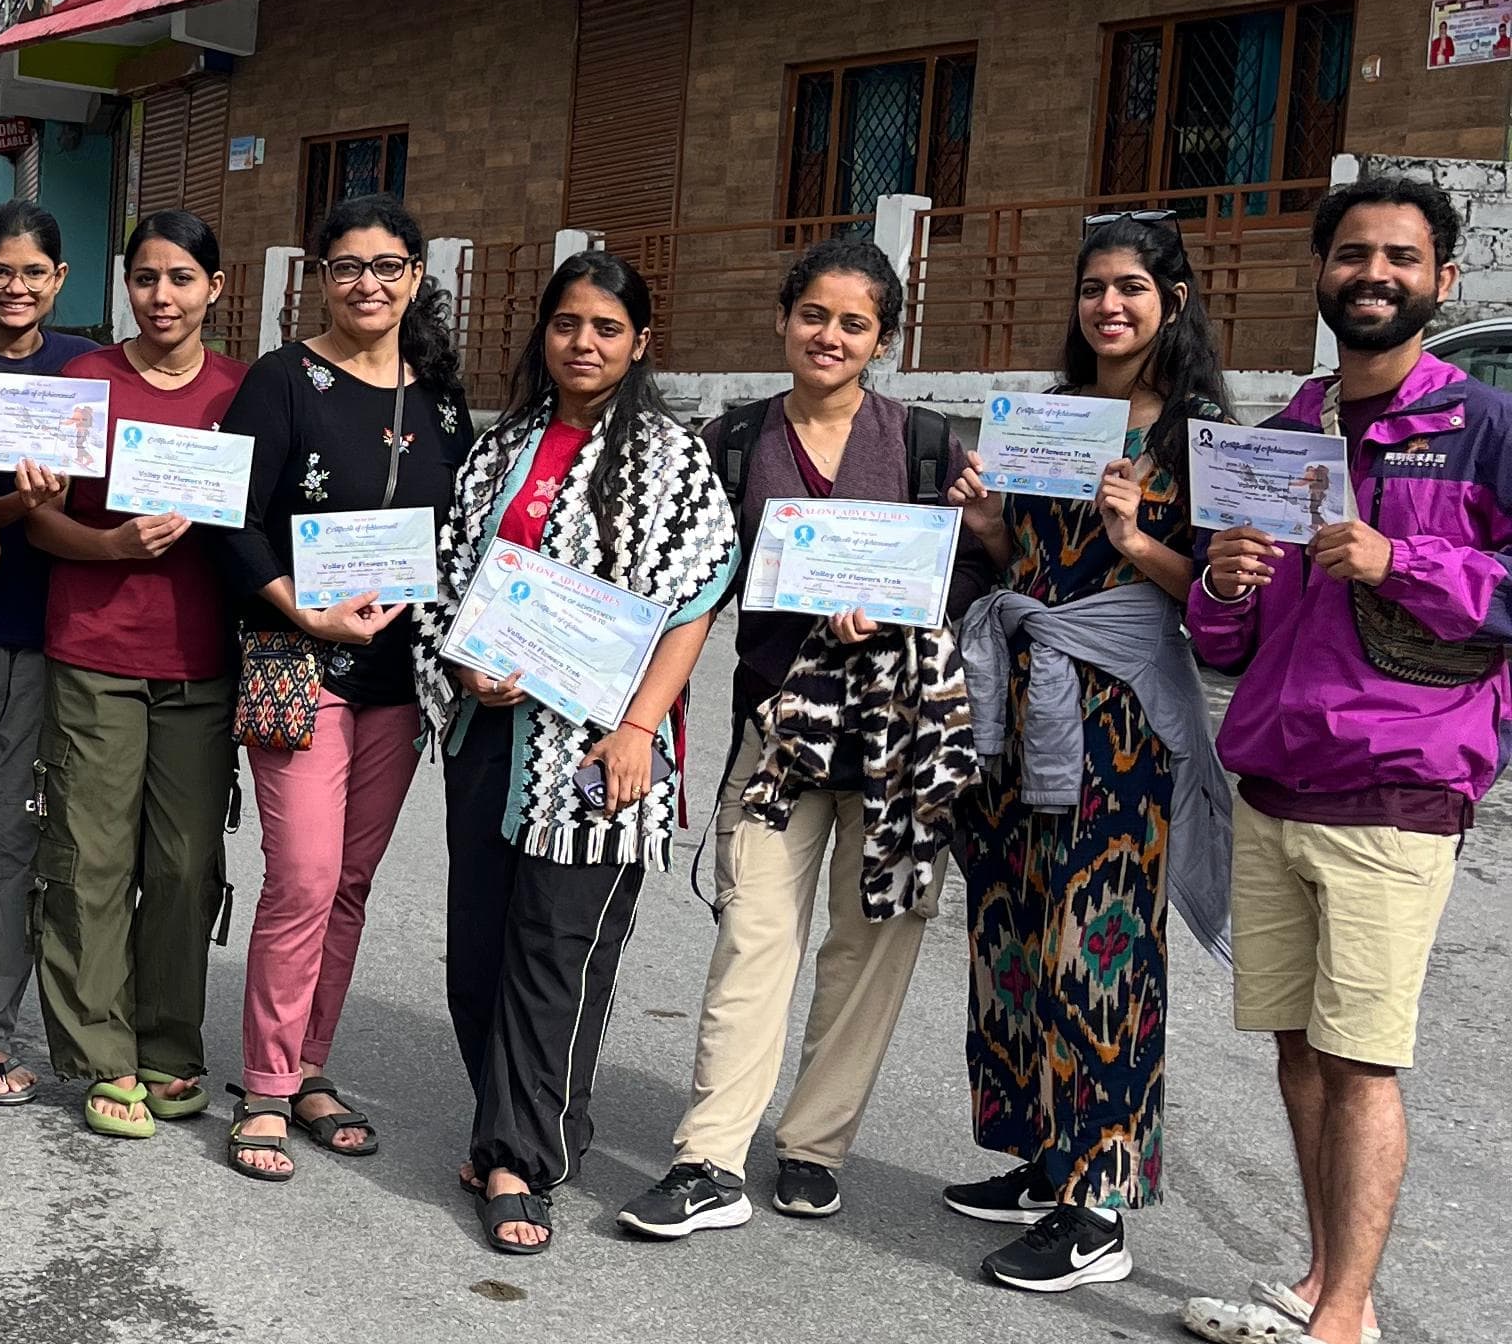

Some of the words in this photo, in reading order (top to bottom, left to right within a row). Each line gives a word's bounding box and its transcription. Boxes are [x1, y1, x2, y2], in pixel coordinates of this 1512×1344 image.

[1005, 444, 1028, 454] Valley
[1041, 447, 1071, 457] Flowers
[1074, 451, 1091, 459] Trek
